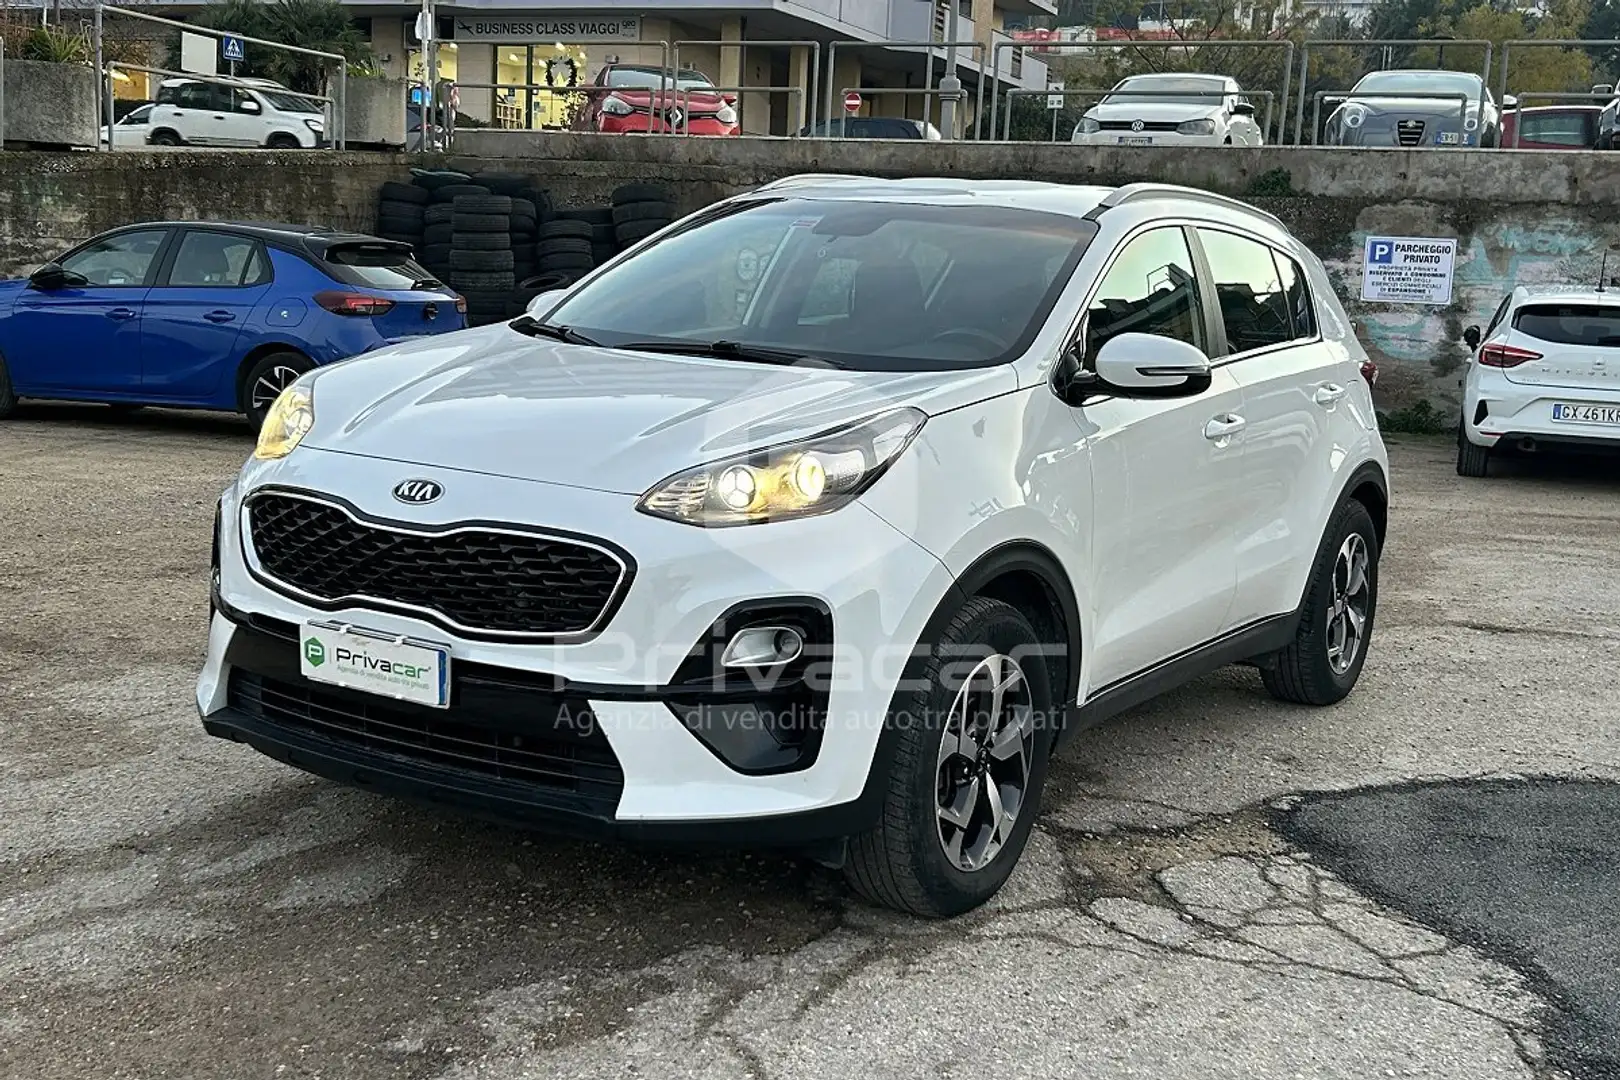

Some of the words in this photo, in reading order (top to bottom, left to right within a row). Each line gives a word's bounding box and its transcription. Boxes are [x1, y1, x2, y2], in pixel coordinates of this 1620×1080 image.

[475, 22, 533, 35] BUSINESS
[536, 22, 576, 35] CLASS
[579, 22, 620, 35] VIAGGI
[1374, 244, 1389, 260] P
[1394, 244, 1451, 254] PARCHEGGIO
[1403, 254, 1441, 264] PRIVATO
[397, 481, 434, 500] KIA
[336, 647, 430, 679] Privacar
